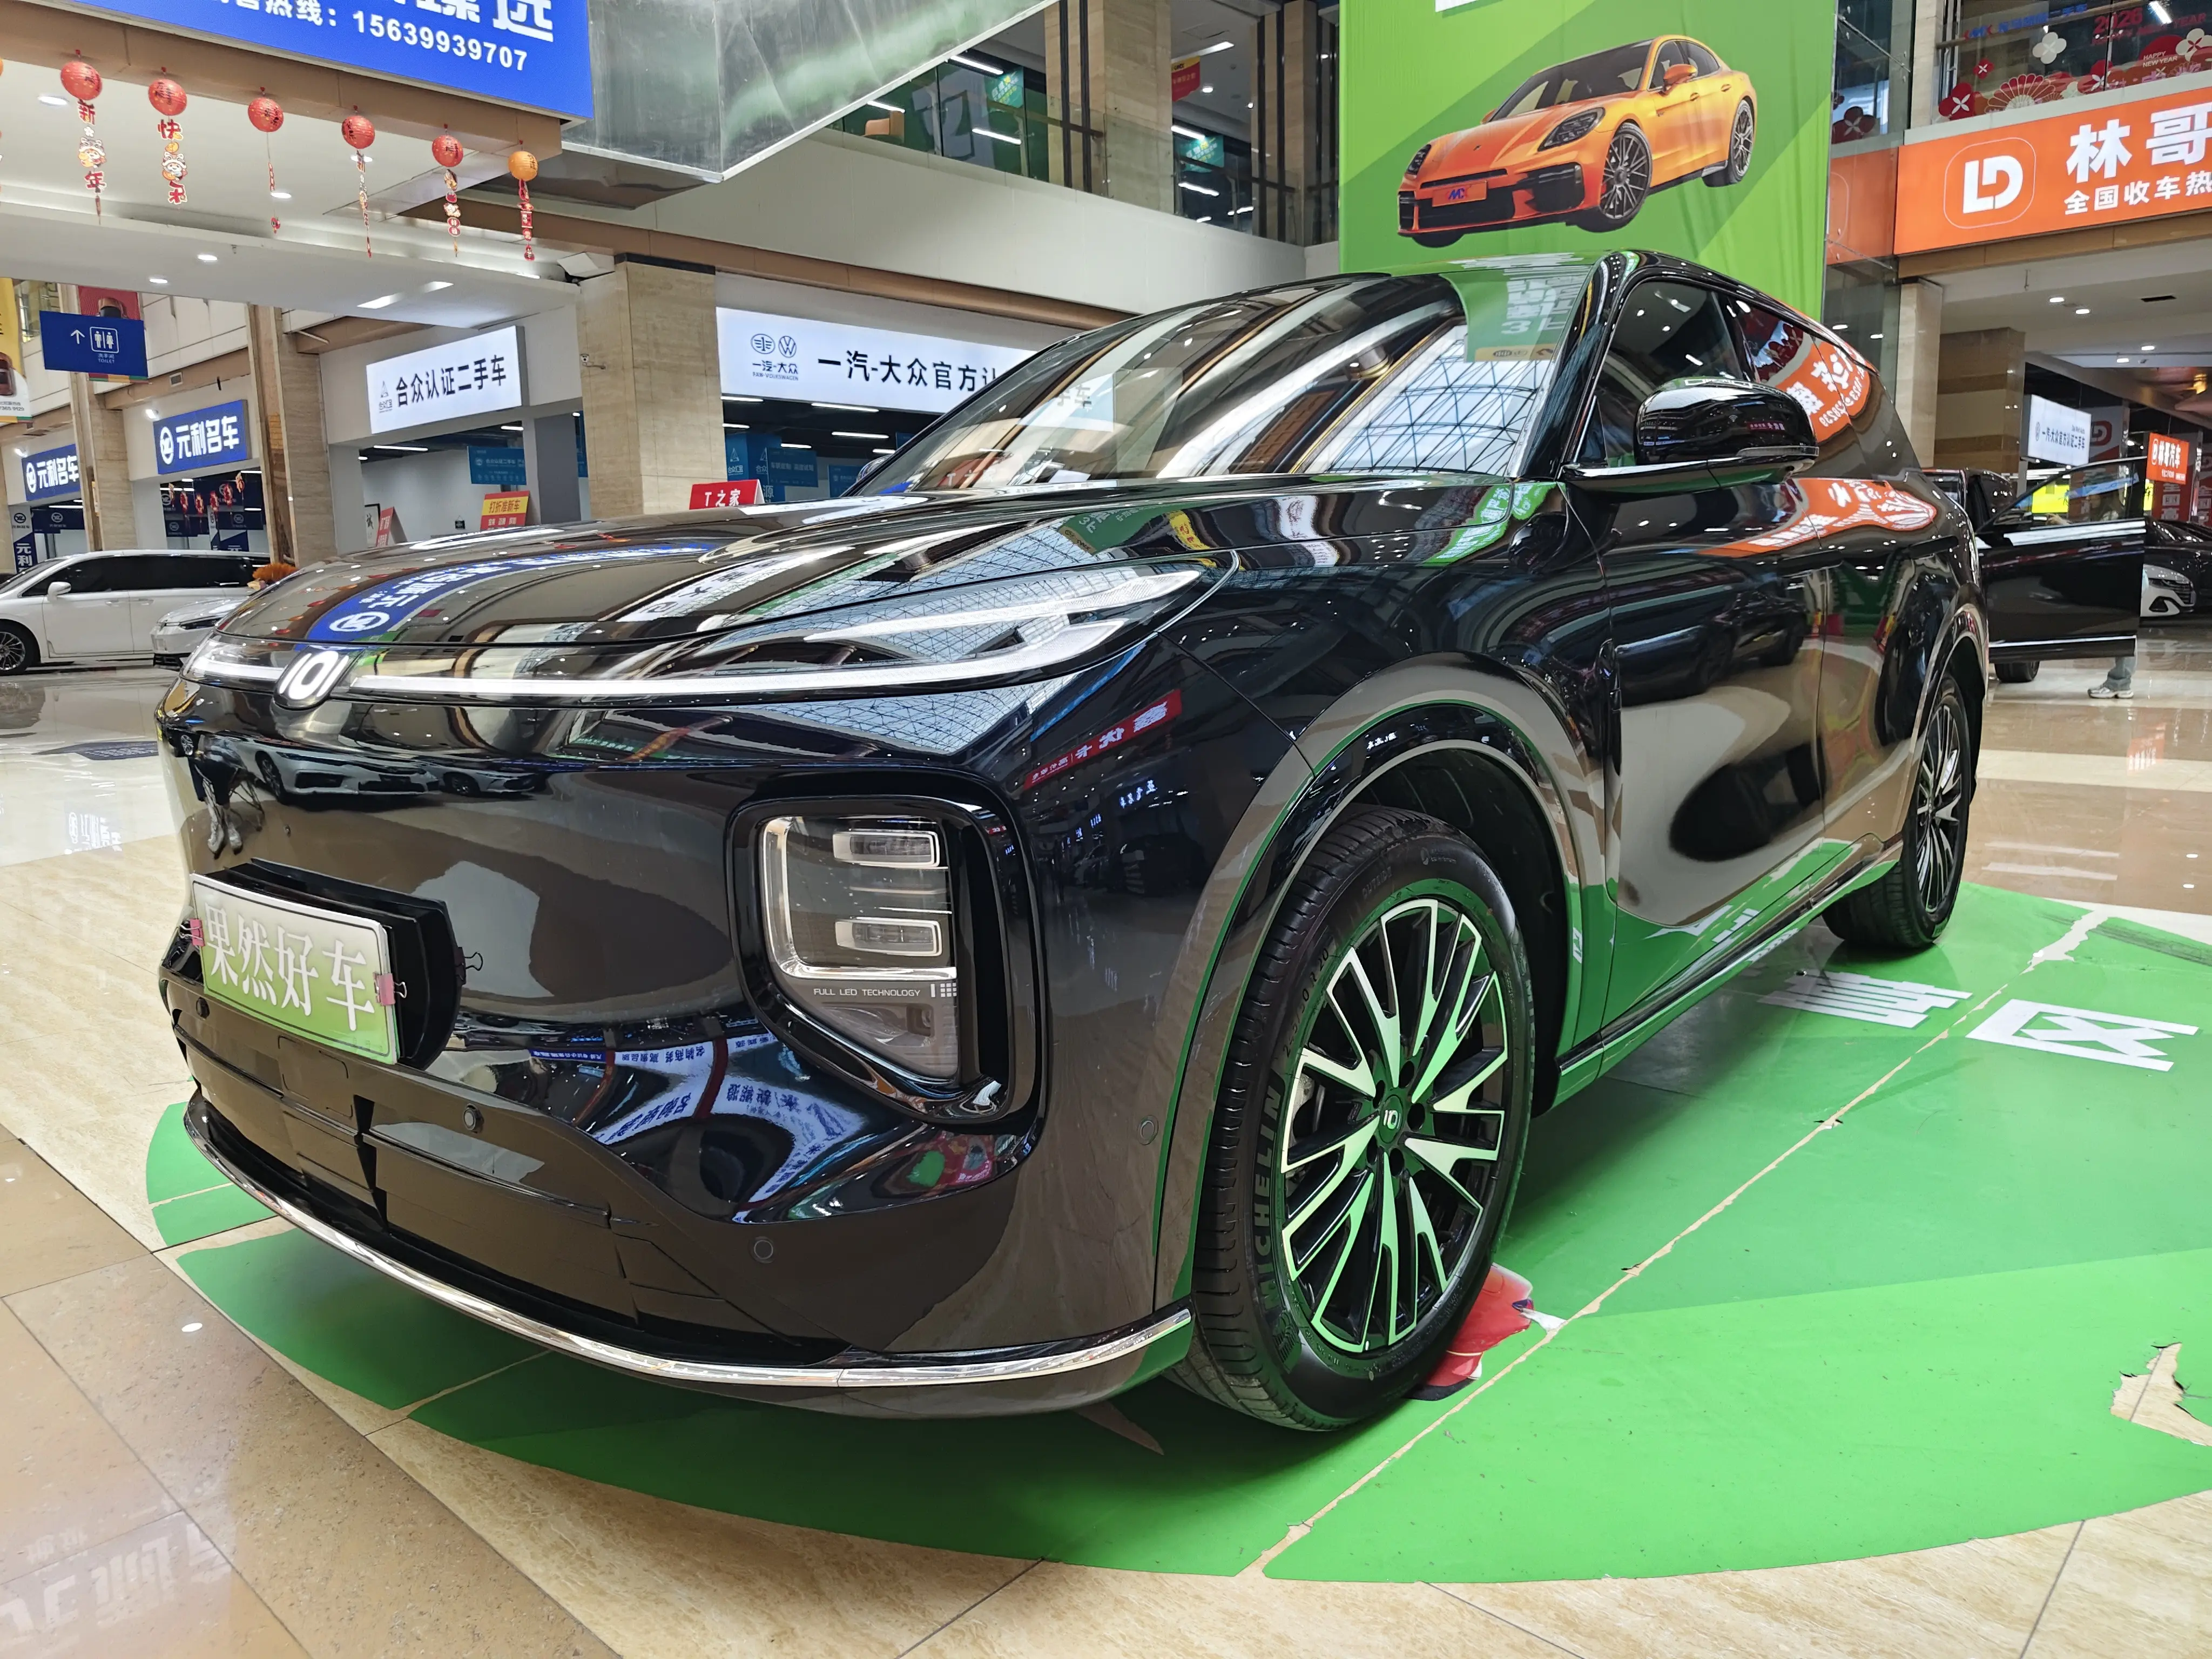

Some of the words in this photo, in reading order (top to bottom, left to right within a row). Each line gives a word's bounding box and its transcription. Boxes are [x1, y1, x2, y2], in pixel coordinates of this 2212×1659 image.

[2142, 59, 2159, 68] NEW
[2160, 56, 2178, 64] YEAR
[2143, 51, 2166, 60] HAPPY
[157, 119, 183, 140] 快
[2066, 102, 2212, 184] 林哥
[396, 355, 507, 407] 合众认证二手车
[752, 360, 799, 375] 一汽-大众
[176, 415, 240, 459] 元利名车
[36, 455, 79, 489] 元利名车
[205, 902, 375, 1031] 果然好车
[840, 988, 858, 996] LED
[862, 989, 921, 997] TECHNOLOGY
[1253, 1083, 1282, 1310] MICHELIN
